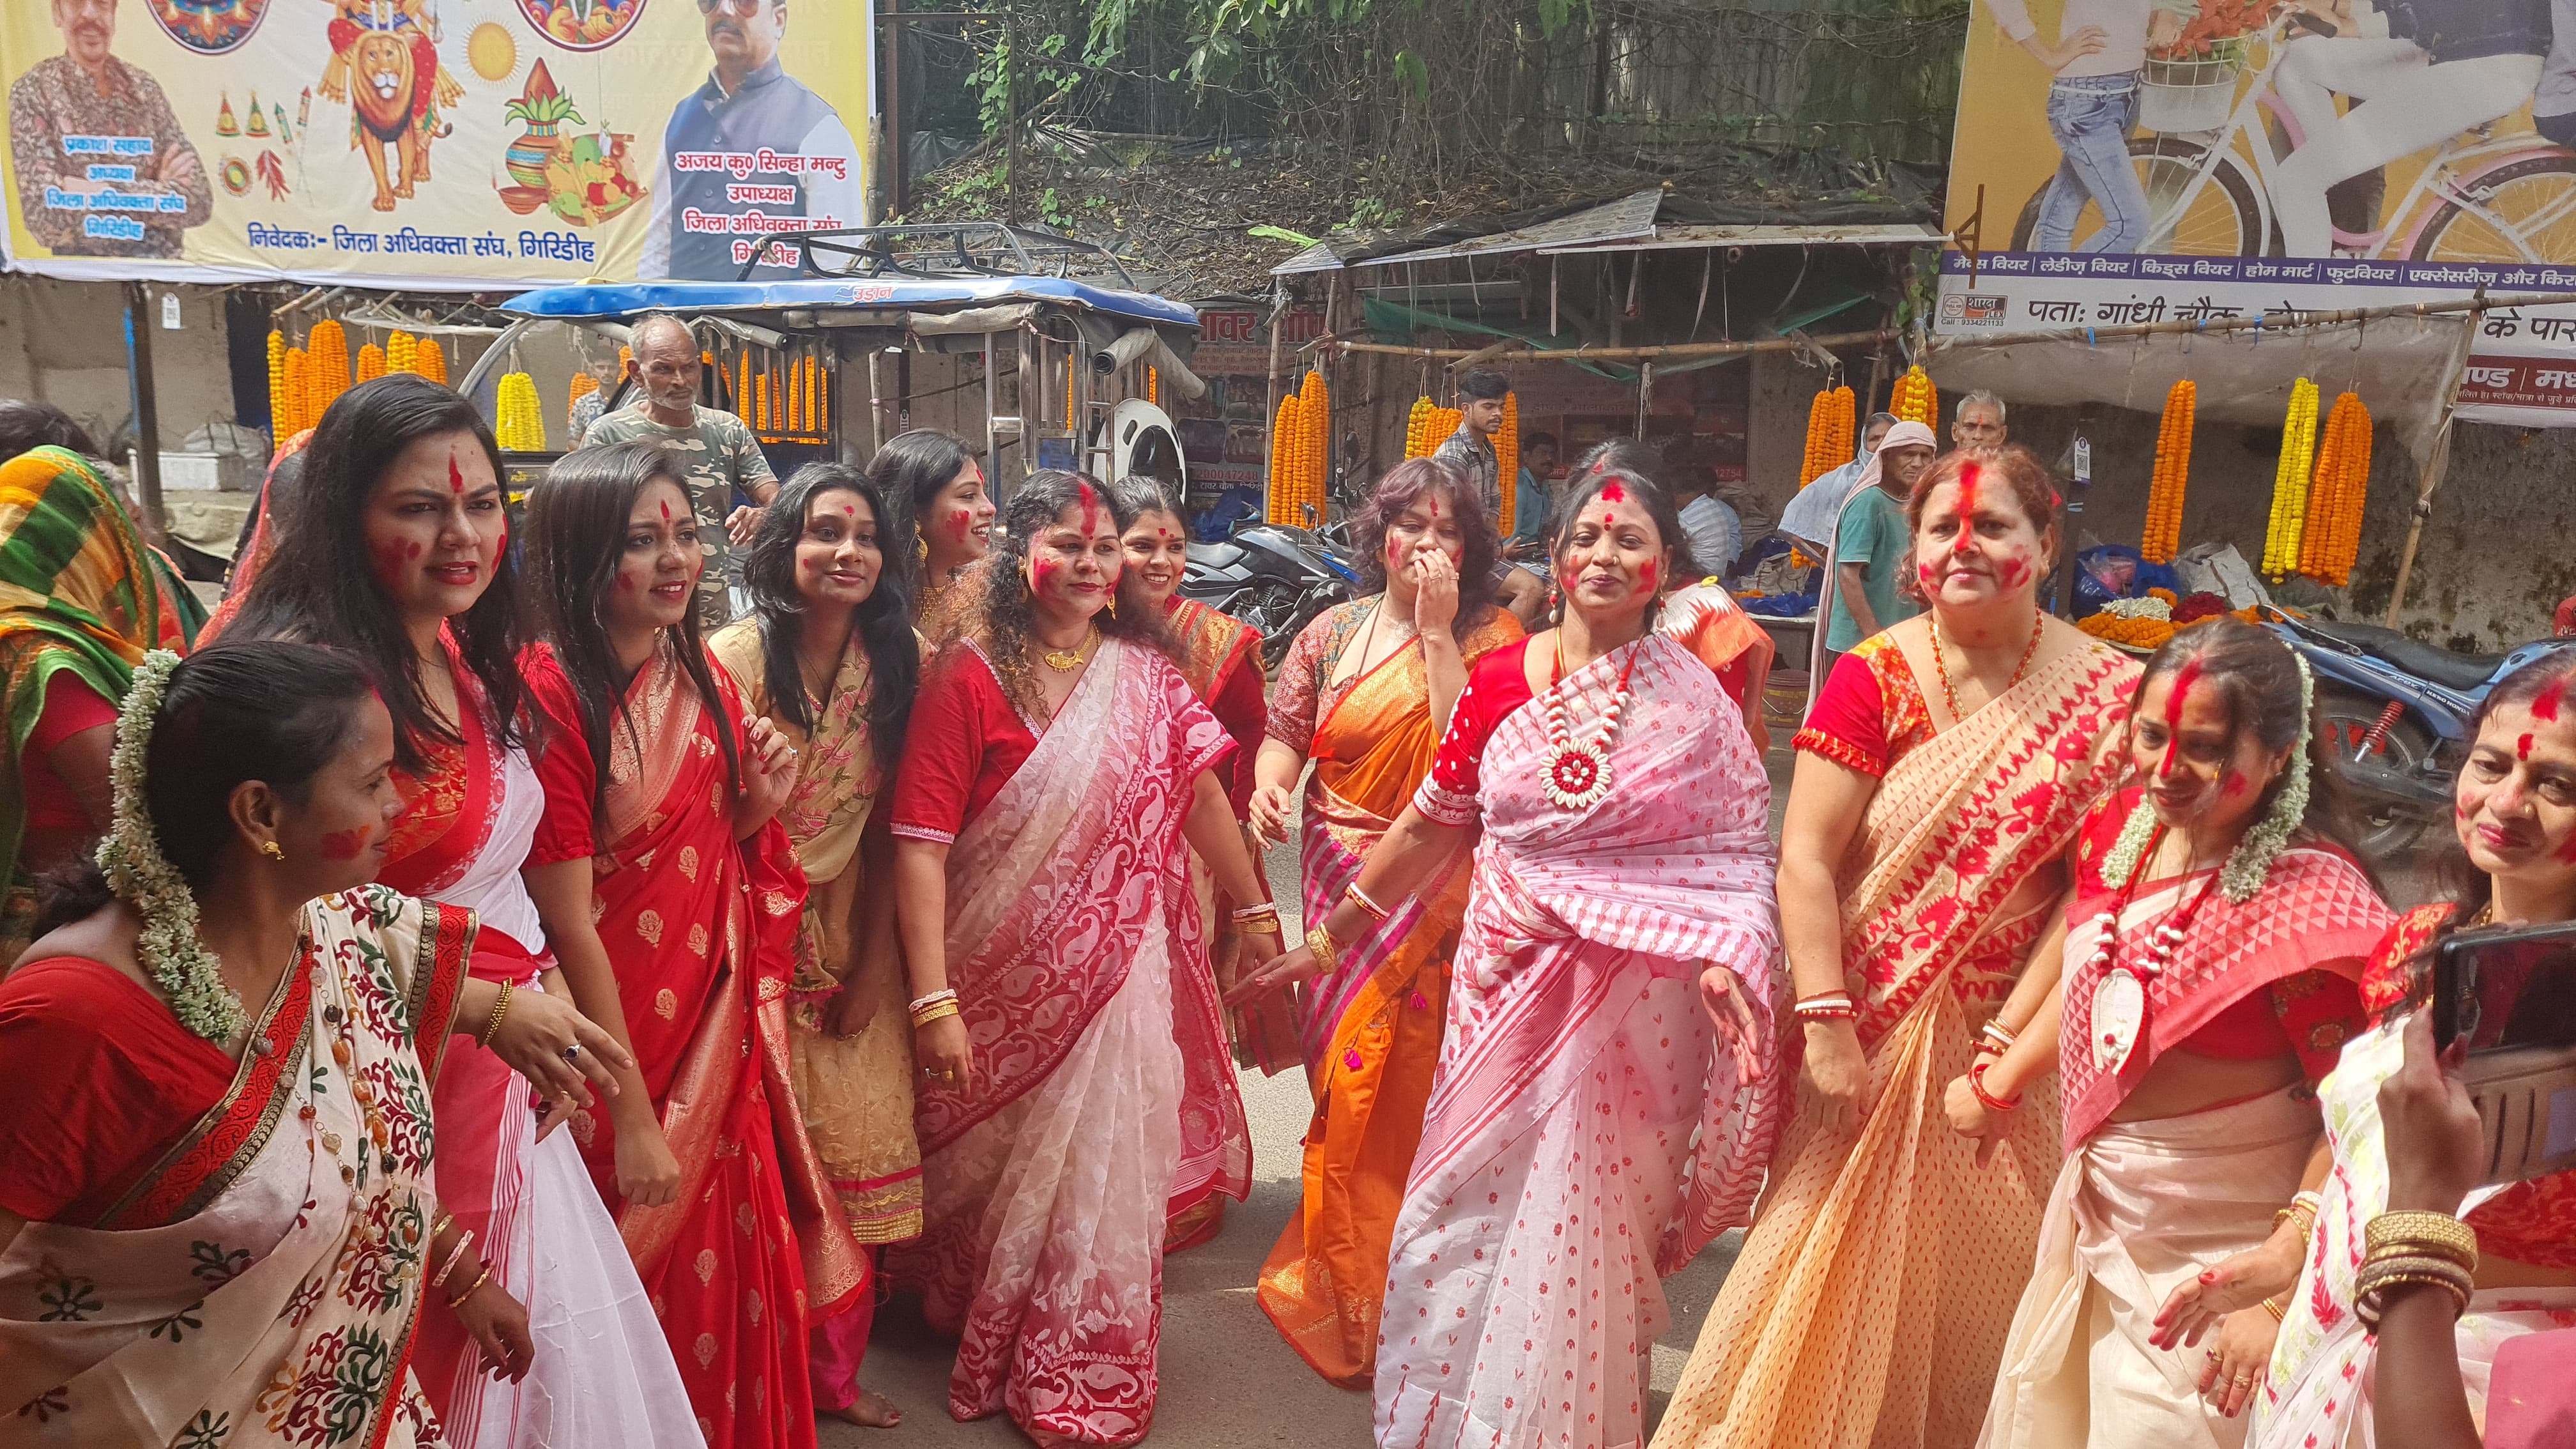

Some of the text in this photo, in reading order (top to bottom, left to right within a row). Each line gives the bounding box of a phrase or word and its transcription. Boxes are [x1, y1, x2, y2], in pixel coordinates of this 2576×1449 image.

[677, 154, 723, 169] अजय
[758, 150, 806, 171] सिन्हा
[810, 157, 847, 180] मन्टु
[46, 188, 185, 211] जिला अधिवक्ता संघ
[728, 186, 793, 202] उपाध्यक्ष
[85, 216, 144, 240] गिरिडीह
[684, 210, 728, 231] जिला
[732, 212, 808, 232] अधिवक्ता
[332, 224, 378, 252] जिला
[383, 227, 467, 255] अधिवक्ता
[518, 231, 595, 263] गिरिडीह
[1992, 256, 2029, 271] वियर
[2040, 257, 2087, 275] लेडीज़
[2091, 257, 2130, 273] वियर
[2142, 259, 2190, 279] किड्स
[2193, 260, 2234, 276] वियर
[2245, 262, 2278, 277] होम
[2282, 263, 2314, 279] मार्ट
[2327, 264, 2396, 284] फुटवियर
[2502, 268, 2538, 285] और
[2097, 294, 2166, 324] गांधी
[2483, 307, 2522, 339] के
